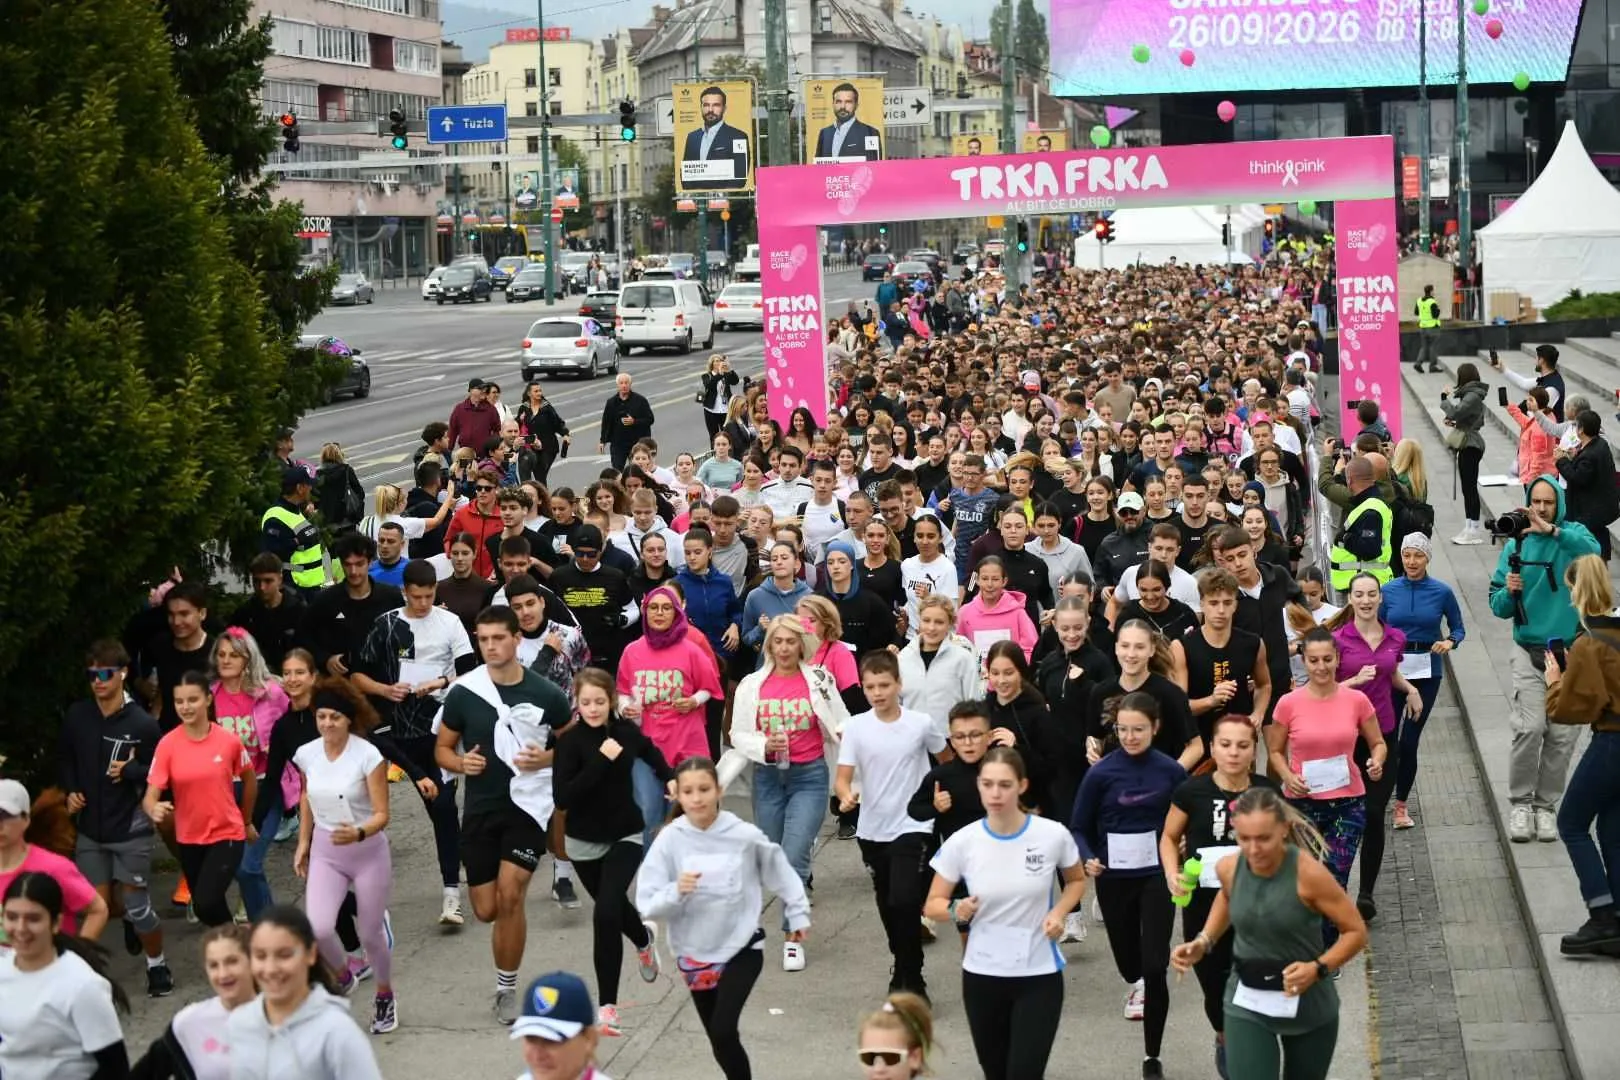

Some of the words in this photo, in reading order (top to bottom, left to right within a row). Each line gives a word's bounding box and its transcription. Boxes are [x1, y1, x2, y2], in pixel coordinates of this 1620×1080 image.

[462, 117, 495, 129] Tuzla
[825, 175, 849, 184] RACE
[951, 161, 1059, 200] TRKA
[1065, 154, 1169, 194] FRKA
[1069, 196, 1116, 209] DOBRO
[1339, 274, 1395, 295] TRKA
[764, 293, 818, 314] TRKA
[1342, 295, 1396, 315] FRKA
[768, 313, 819, 334] FRKA
[634, 669, 684, 689] TRKA
[1025, 855, 1045, 864] NRC
